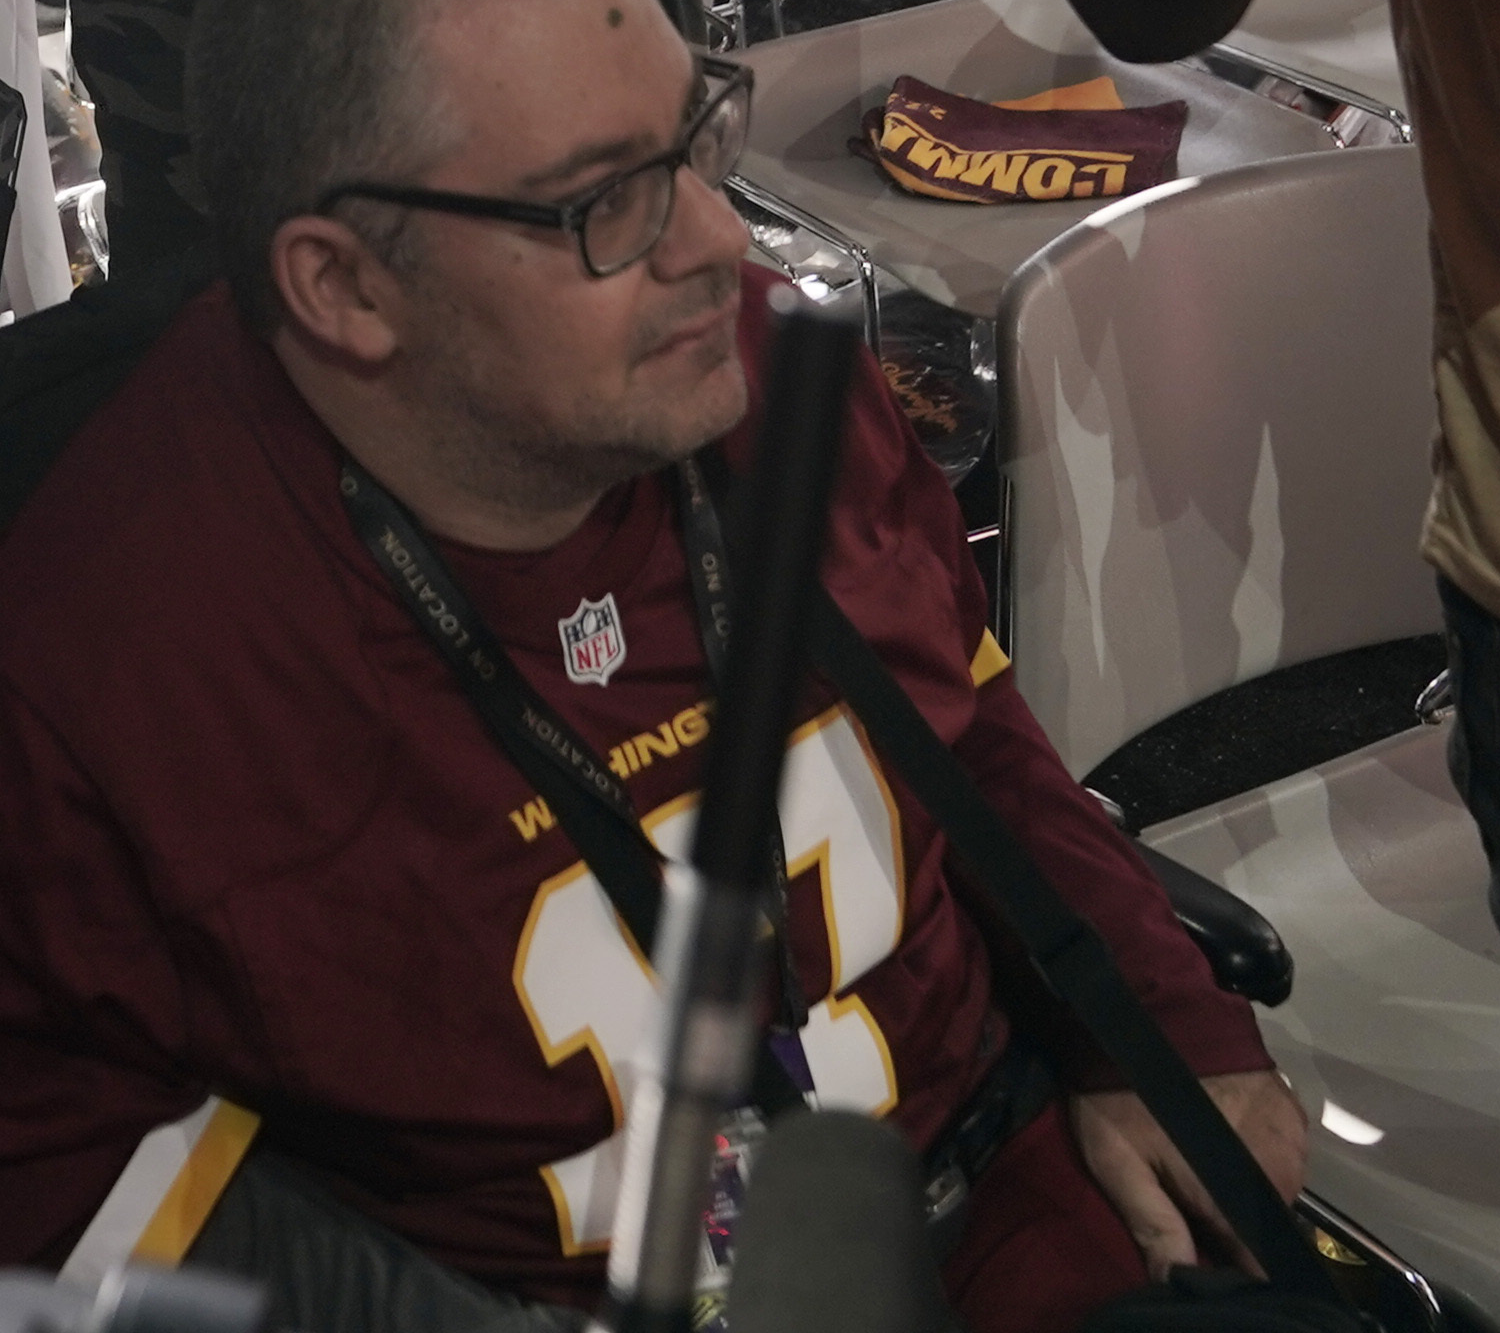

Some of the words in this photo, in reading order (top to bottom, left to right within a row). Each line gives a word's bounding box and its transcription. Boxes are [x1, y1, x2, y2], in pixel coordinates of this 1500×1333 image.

[380, 523, 470, 649] LOCATION
[700, 552, 723, 592] ON
[572, 629, 618, 673] NFL
[520, 706, 622, 803] LOCATION
